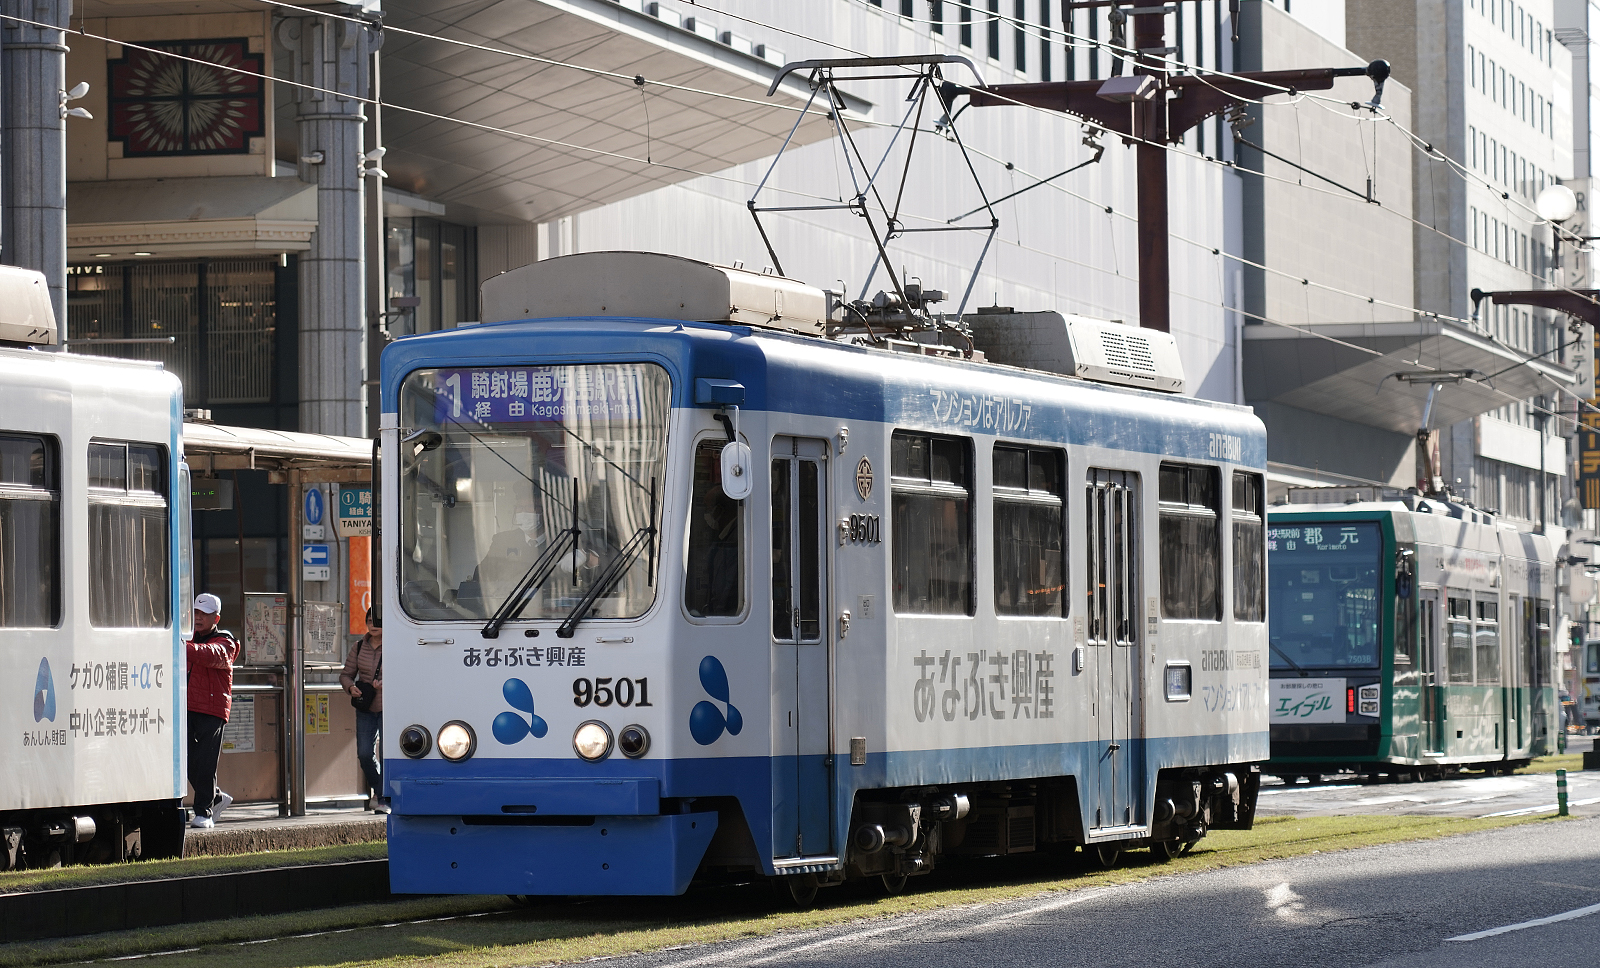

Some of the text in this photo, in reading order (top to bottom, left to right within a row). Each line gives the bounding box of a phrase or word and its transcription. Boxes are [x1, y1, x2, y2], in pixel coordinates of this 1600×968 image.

[445, 368, 637, 418] 1 騎射場 鹿児島駅前
[531, 403, 637, 418] Kagoshimaeki-mae
[929, 389, 1032, 432] マンションはアルファ
[349, 507, 364, 516] 経由
[341, 520, 372, 528] TANIYA
[850, 513, 881, 543] 9501
[463, 646, 586, 667] あなぶき興産
[1348, 654, 1372, 664] 7503B
[572, 676, 654, 709] 9501
[913, 649, 1055, 723] あなぶき興産
[1274, 695, 1333, 718] エイブル
[69, 707, 165, 738] 中小企業をサポート
[22, 729, 67, 747] あんしん財団
